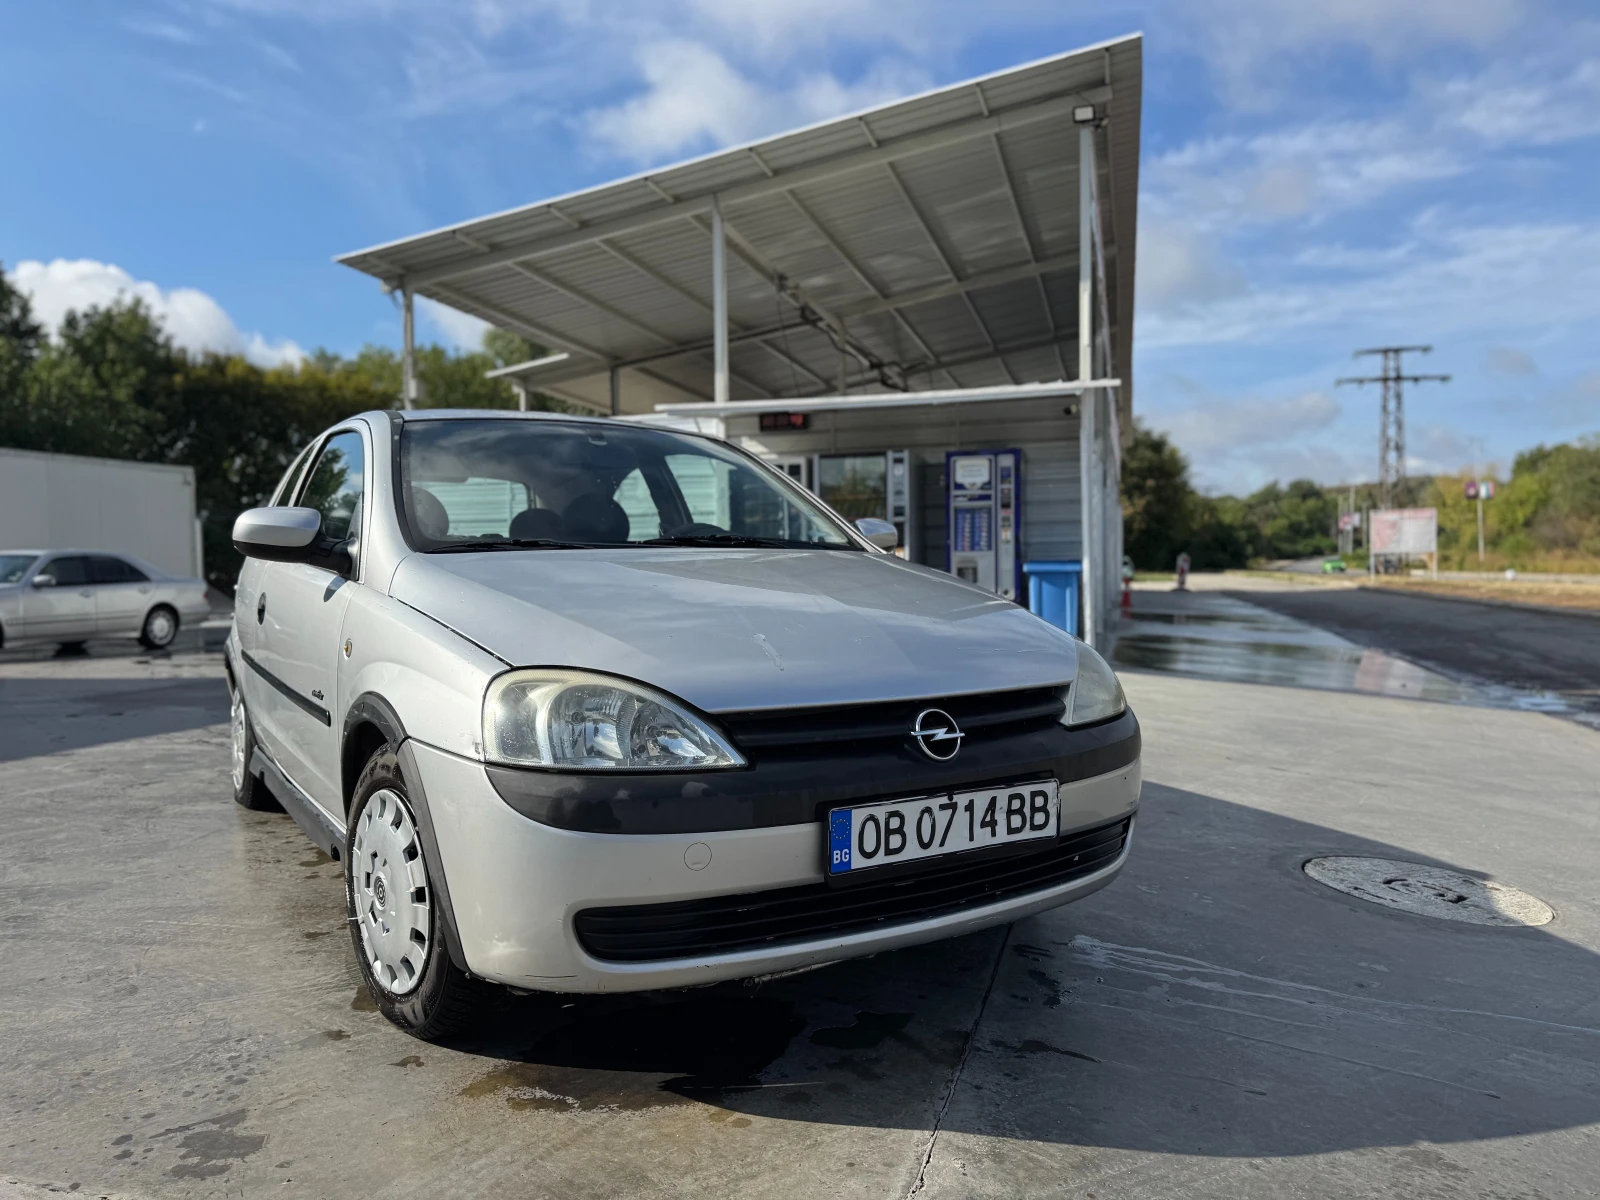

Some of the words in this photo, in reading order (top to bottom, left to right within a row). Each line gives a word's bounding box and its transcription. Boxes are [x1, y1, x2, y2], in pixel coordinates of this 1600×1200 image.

[858, 810, 907, 859] OB
[916, 796, 998, 850] 0714
[1006, 790, 1050, 835] BB
[833, 848, 849, 864] BG
